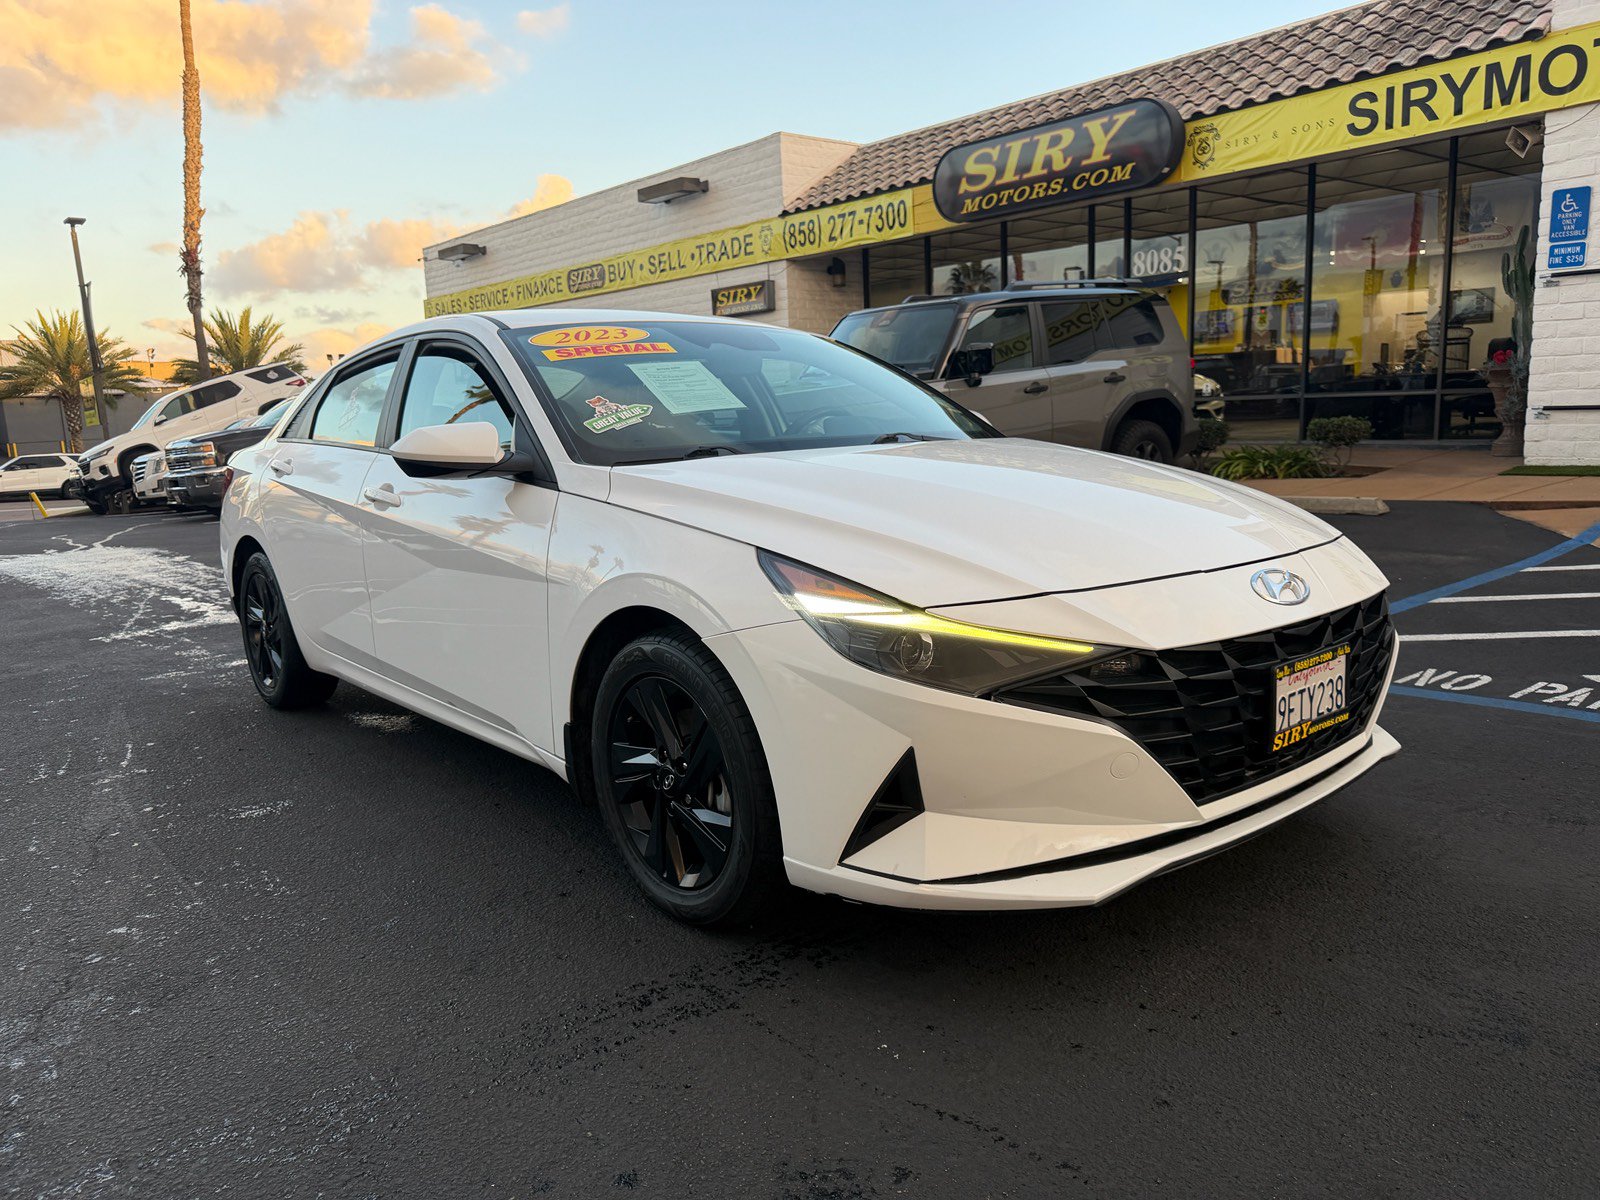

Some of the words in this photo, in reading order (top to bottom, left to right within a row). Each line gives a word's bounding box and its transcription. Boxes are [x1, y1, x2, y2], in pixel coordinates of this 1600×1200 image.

[1346, 37, 1600, 137] SIRYMO
[1225, 134, 1261, 149] SIRY
[1291, 118, 1335, 135] SONS
[957, 109, 1137, 195] SIRY
[960, 162, 1136, 215] MOTORS.COM
[783, 214, 822, 253] (858)
[828, 199, 907, 242] 277-7300
[1557, 211, 1583, 220] PARKING
[1551, 229, 1586, 238] ACCESSIBLE
[608, 259, 636, 283] BUY
[648, 250, 687, 275] SELL
[695, 233, 755, 266] TRADE
[1133, 246, 1186, 276] 8085
[1549, 256, 1563, 265] FINE
[1565, 254, 1583, 264] $250
[1553, 246, 1581, 255] MINIMUM
[570, 266, 602, 285] SIRY
[435, 297, 463, 316] SALES
[468, 288, 509, 311] SERVICE
[515, 275, 563, 301] FINANCE
[716, 285, 763, 307] SIRY
[555, 328, 629, 344] 2023
[555, 342, 670, 358] SPECIAL
[592, 415, 620, 429] GREAT
[618, 406, 644, 420] VALUE
[1393, 668, 1493, 691] NO
[1273, 721, 1312, 752] SIRY
[1308, 713, 1350, 735] MOTORS.COM
